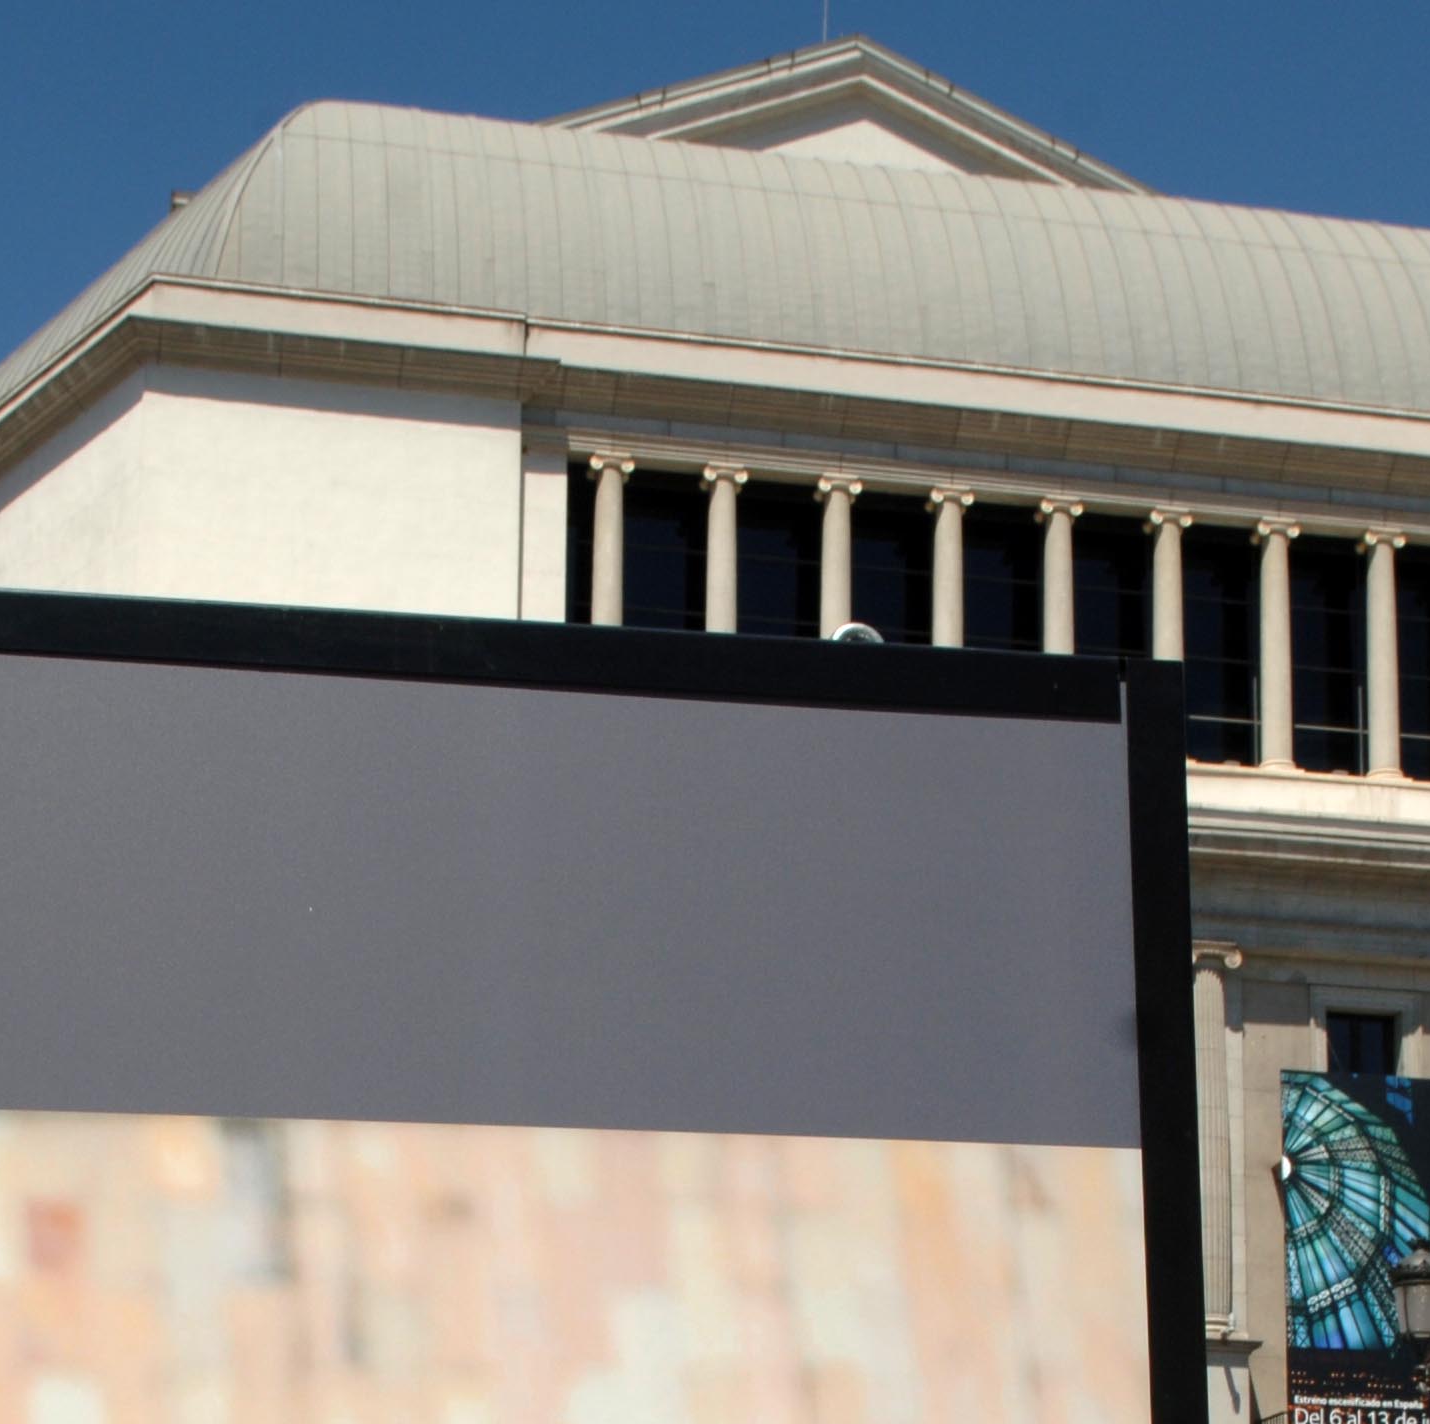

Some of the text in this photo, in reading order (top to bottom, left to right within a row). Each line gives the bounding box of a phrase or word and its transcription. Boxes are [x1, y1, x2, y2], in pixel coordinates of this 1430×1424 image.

[1294, 1395, 1327, 1405] Estreno
[1328, 1396, 1381, 1407] escenificado
[1394, 1400, 1424, 1410] España
